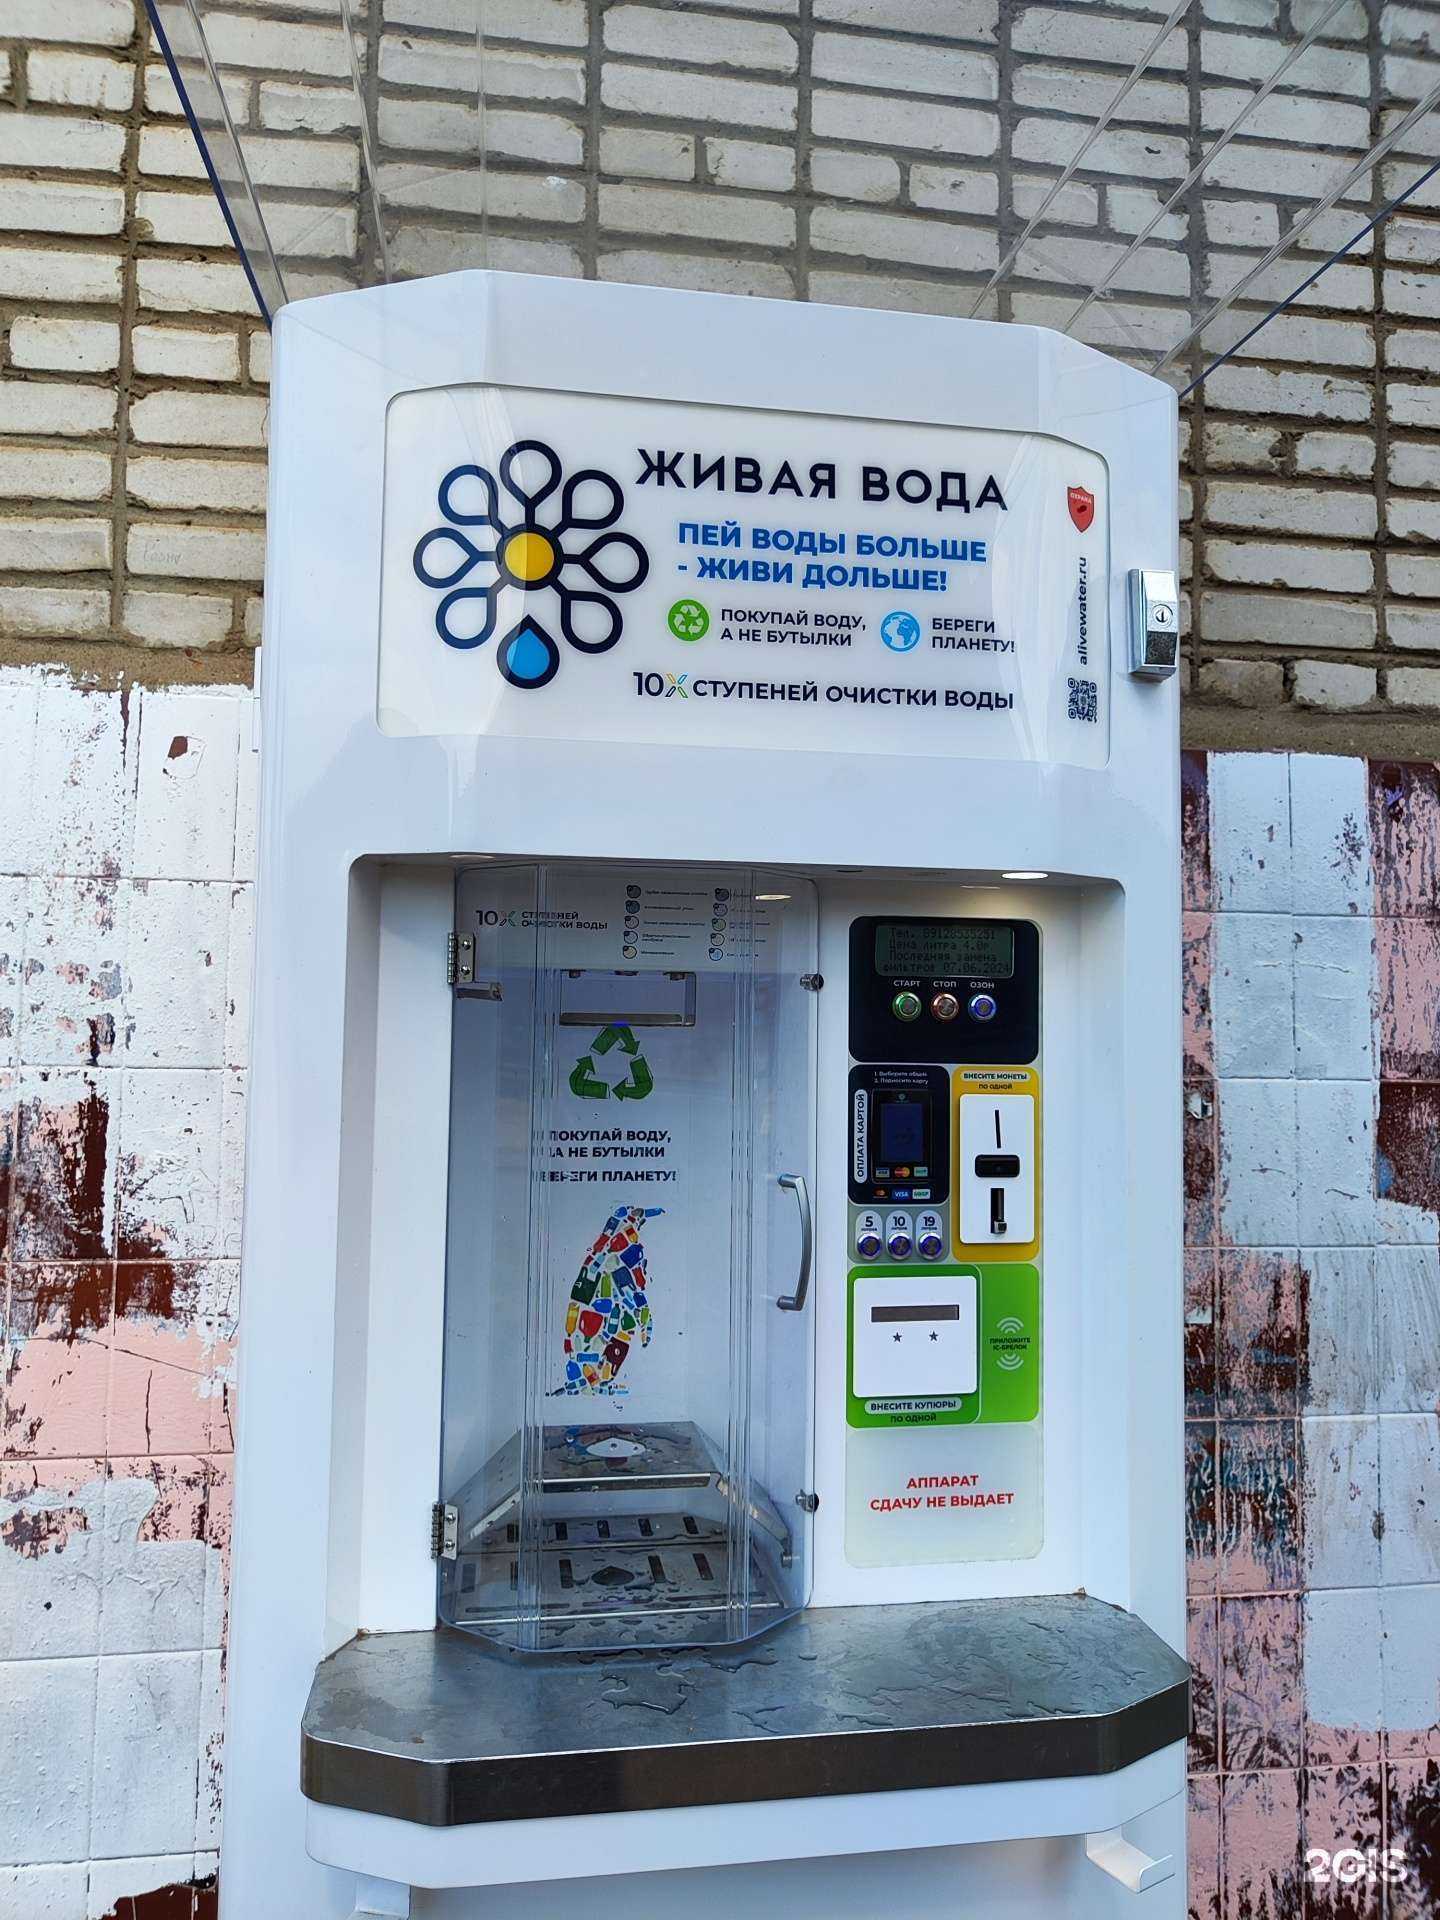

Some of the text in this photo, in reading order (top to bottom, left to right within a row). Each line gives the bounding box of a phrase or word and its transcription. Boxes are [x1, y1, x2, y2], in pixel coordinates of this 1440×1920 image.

[635, 448, 1008, 513] ЖИВАЯ ВОДА
[679, 520, 986, 562] ПЕЙ ВОДЫ БОЛЬШЕ
[697, 557, 793, 584] ЖИВИ
[802, 564, 947, 592] ДОЛЬШЕ!
[1077, 557, 1087, 665] alivewater.ru
[721, 608, 866, 632] ПОКУПАЙ ВОДУ,
[932, 617, 995, 633] БЕРЕГИ
[721, 628, 852, 647] А НЕ БУТЫЛКИ
[932, 636, 1015, 654] ПЛАНЕТУ!
[693, 680, 818, 702] СТУПЕНЕЙ
[825, 686, 937, 706] ОЧИСТКИ
[945, 691, 1013, 710] ВОДЫ
[576, 921, 608, 930] ВОДЫ
[970, 981, 994, 989] ОЗОН
[626, 1130, 672, 1143] ВОДУ,
[856, 1093, 865, 1178] ОПЛАТА КАРТОЙ
[568, 1146, 588, 1157] НЕ
[592, 1146, 665, 1158] БУТЫЛКИ
[602, 1170, 676, 1182] ПЛАНЕТУ!
[865, 1216, 874, 1227] 5
[892, 1216, 905, 1227] 10
[923, 1216, 936, 1227] 19
[870, 1401, 957, 1411] ВНЕСИТЕ КУПЮРЫ
[890, 1412, 937, 1423] ПО ОДНОЙ
[906, 1475, 979, 1489] АППАРАТ
[870, 1493, 1014, 1512] СДАЧУ НЕ ВЫДАЕТ
